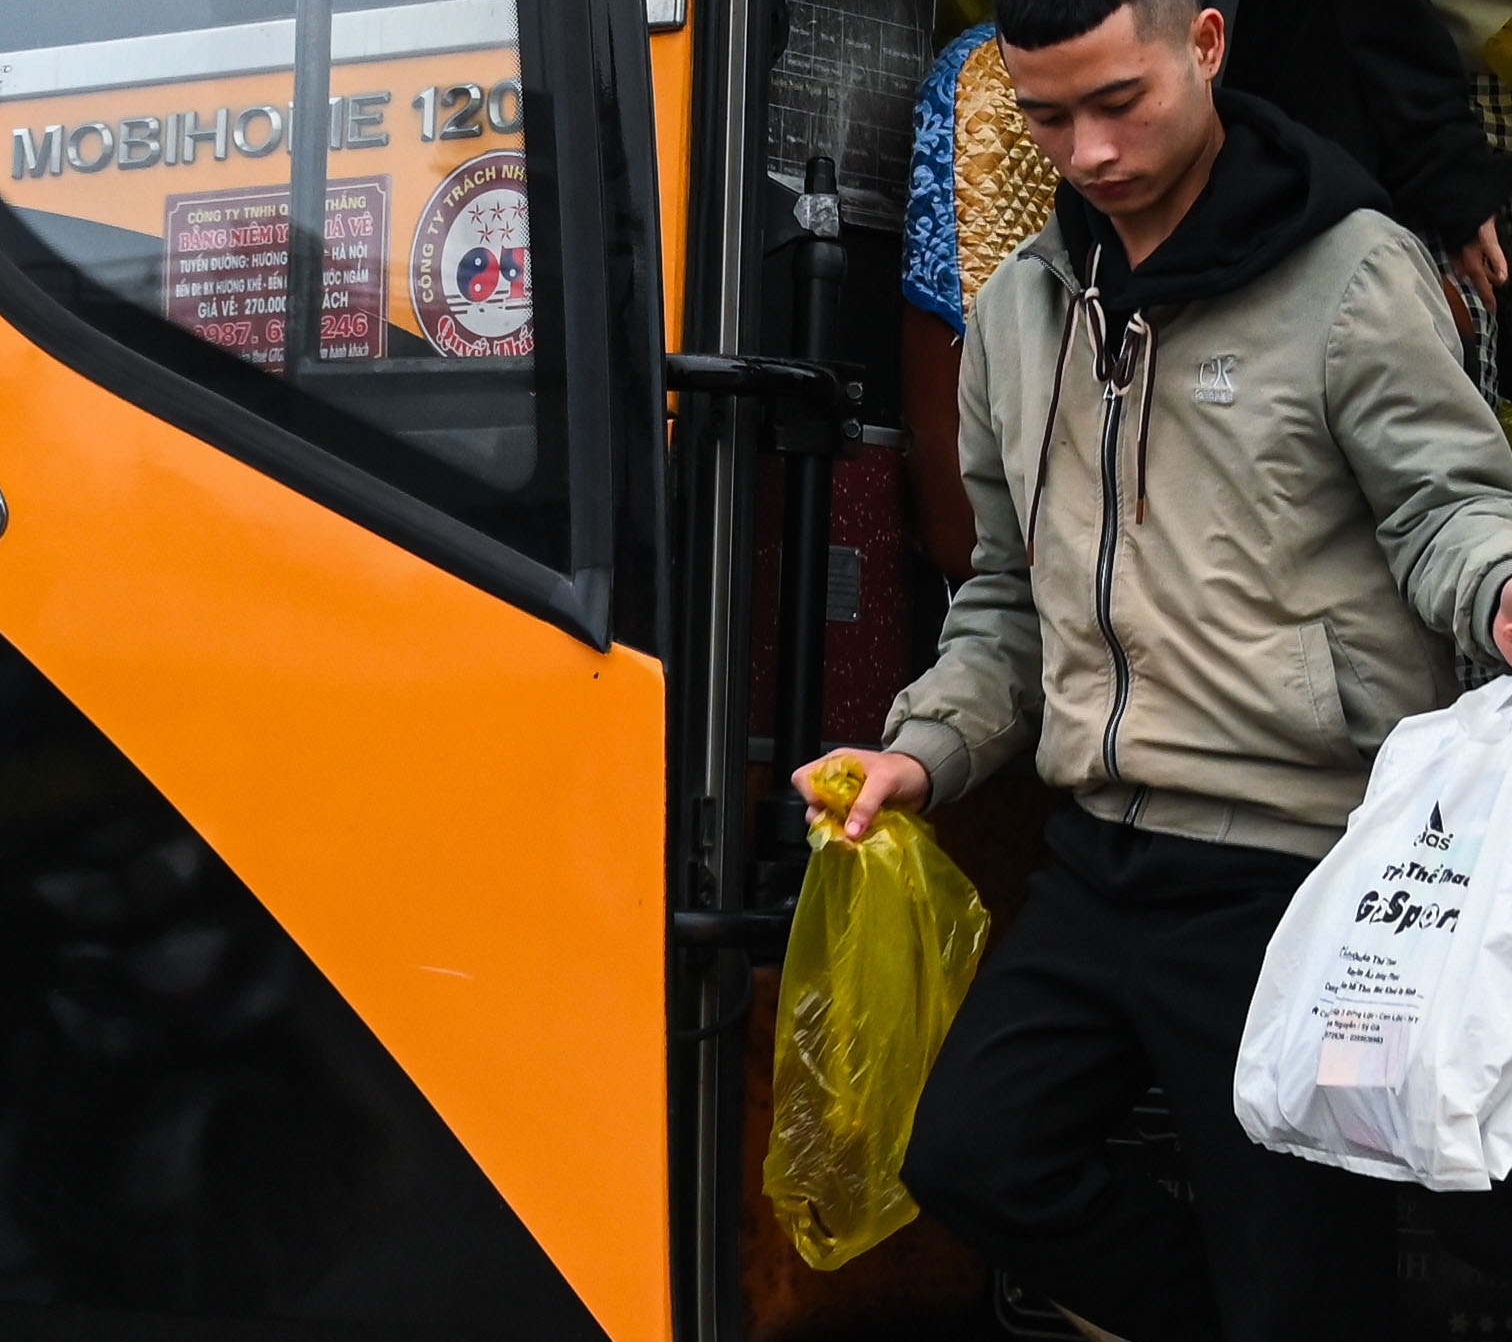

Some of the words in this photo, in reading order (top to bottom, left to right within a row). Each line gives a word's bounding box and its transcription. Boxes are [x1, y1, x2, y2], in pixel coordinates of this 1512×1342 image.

[10, 90, 391, 179] MOBIHOE
[412, 79, 523, 144] 120
[188, 209, 221, 224] CÔNG
[225, 208, 240, 220] TY
[244, 205, 275, 219] TNHH
[178, 225, 226, 252] BẢNG
[230, 221, 273, 247] NIÊM
[324, 213, 345, 239] IÁ
[418, 243, 434, 303] CÔNG
[427, 209, 444, 235] TY
[443, 165, 496, 207] TRÁCH
[332, 243, 346, 260] HÀ
[349, 241, 368, 261] NỘI
[221, 295, 239, 317] VÉ:
[320, 312, 369, 339] 246
